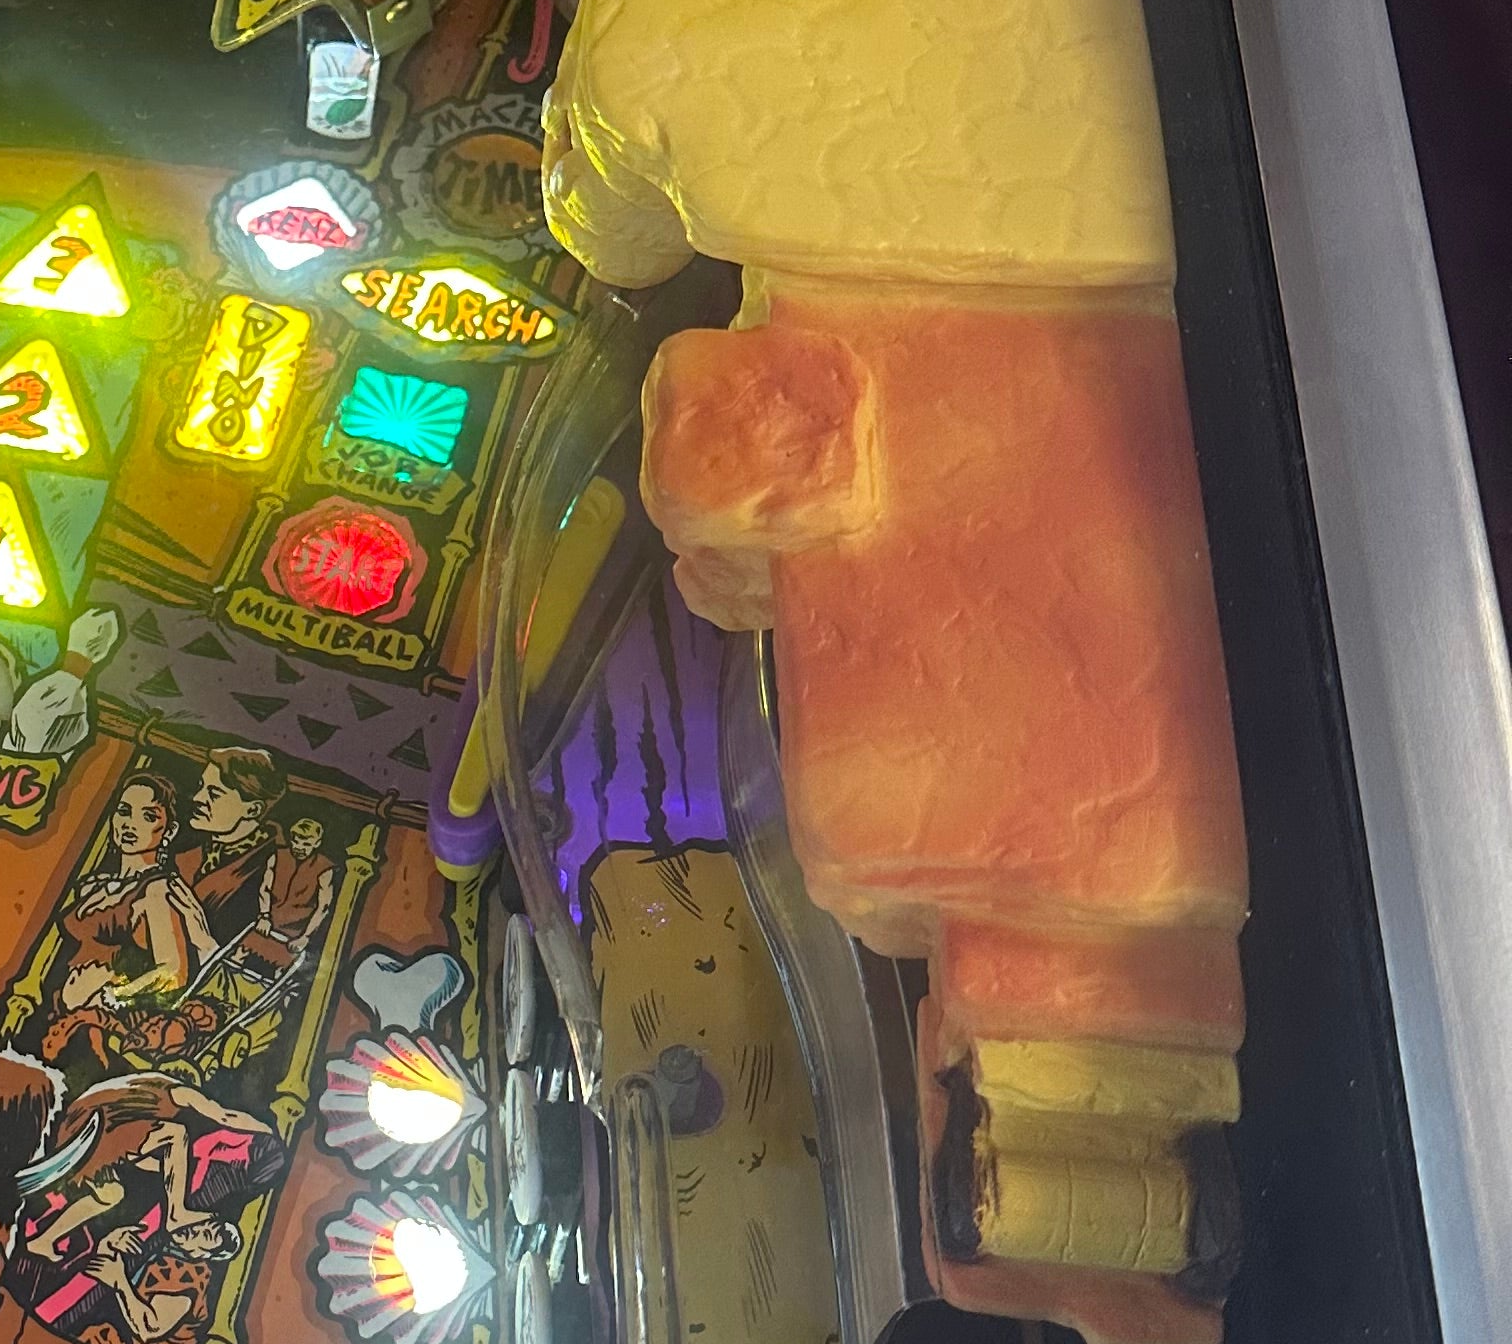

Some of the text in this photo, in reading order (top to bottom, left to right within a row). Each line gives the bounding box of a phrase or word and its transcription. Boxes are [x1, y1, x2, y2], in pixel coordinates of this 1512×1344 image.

[32, 235, 94, 294] 3
[354, 268, 544, 345] SEARCH
[207, 301, 290, 448] DINO
[317, 457, 441, 506] CHANGE
[234, 594, 415, 664] MULTIBALL
